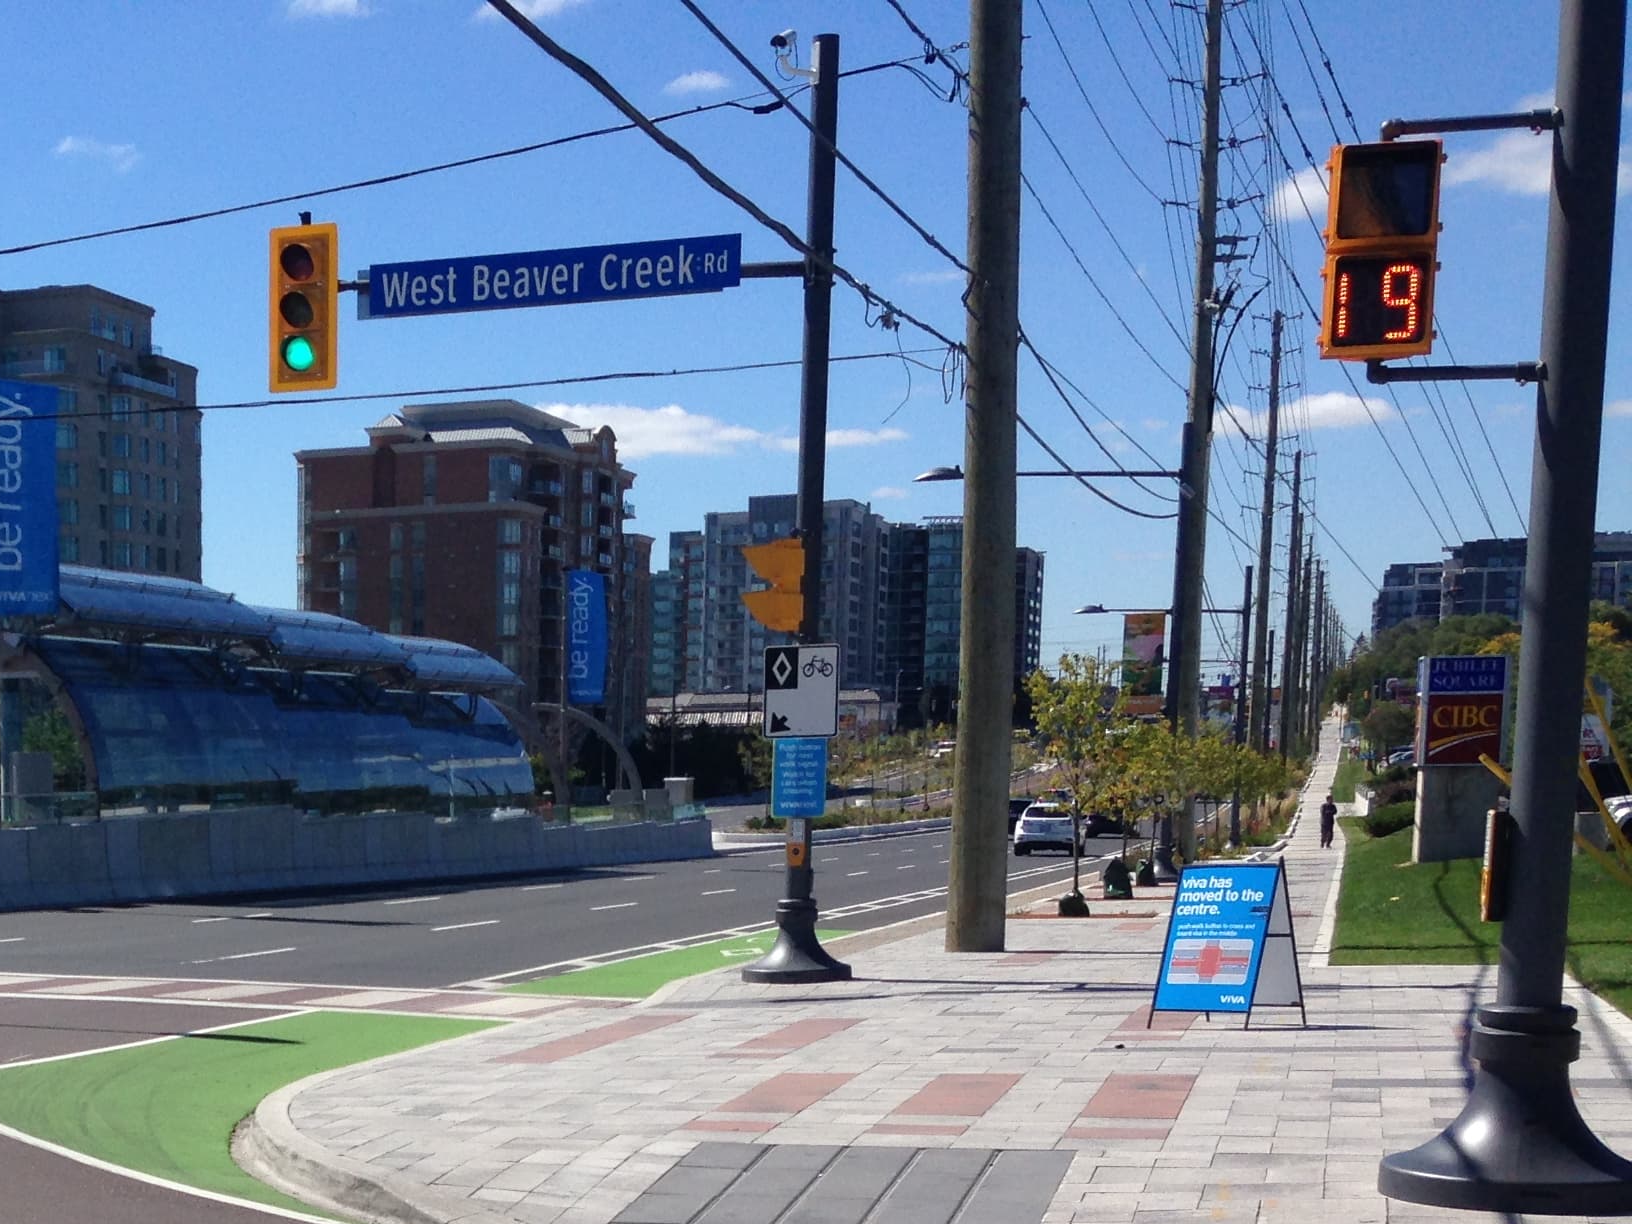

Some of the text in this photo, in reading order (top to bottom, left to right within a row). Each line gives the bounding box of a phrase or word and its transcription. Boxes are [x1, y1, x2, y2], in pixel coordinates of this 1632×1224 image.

[381, 245, 728, 308] West Beaver Creek Rd
[1337, 265, 1418, 339] 19
[1432, 675, 1498, 690] SQUARE
[1432, 704, 1498, 729] CIBC
[1182, 875, 1232, 889] viva has
[1179, 888, 1264, 902] moved to the
[1176, 903, 1221, 916] centre.
